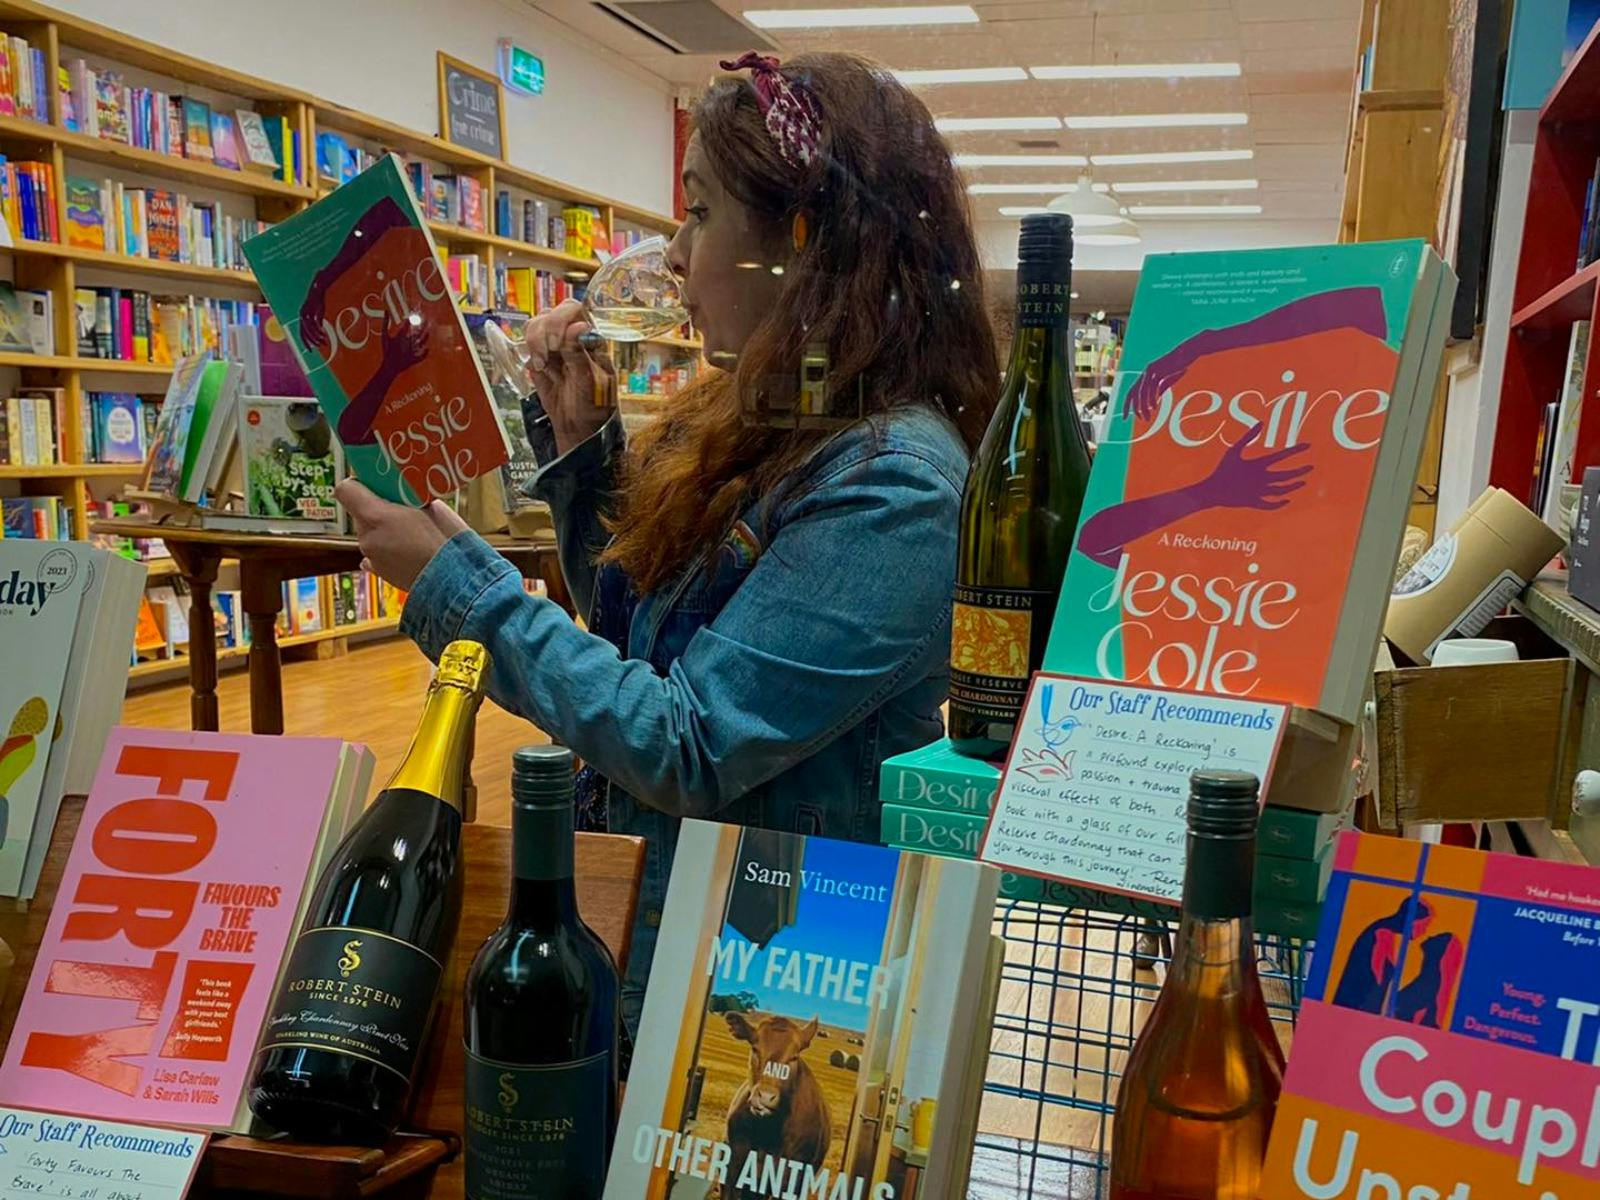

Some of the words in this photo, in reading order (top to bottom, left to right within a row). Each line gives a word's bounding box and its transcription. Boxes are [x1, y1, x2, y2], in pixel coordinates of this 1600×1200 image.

[374, 396, 473, 476] Jessie
[289, 462, 330, 478] Step-
[397, 446, 480, 509] Cole
[281, 476, 305, 492] by-
[302, 484, 335, 500] step
[1159, 533, 1170, 546] A
[1173, 533, 1258, 557] Reckoning
[46, 566, 68, 576] 2023
[0, 570, 57, 617] day
[987, 594, 1032, 607] STEIN
[1088, 552, 1300, 630] Jessie
[1096, 621, 1262, 697] Cole
[1069, 686, 1103, 711] Our
[1105, 690, 1151, 715] Staff
[1151, 695, 1275, 731] Recommends
[1136, 730, 1147, 742] A
[1223, 746, 1237, 757] is
[1099, 751, 1148, 768] profound
[1081, 769, 1121, 784] passion
[1142, 780, 1181, 794] trauma
[1011, 783, 1051, 797] visceral
[1059, 788, 1100, 805] effects
[1110, 796, 1122, 806] of
[1005, 802, 1026, 817] book
[1034, 808, 1059, 820] with
[1066, 815, 1073, 824] a
[1080, 818, 1111, 833] glass
[1118, 823, 1131, 836] of
[1136, 828, 1158, 838] our
[998, 820, 1038, 840] Reserve
[1148, 852, 1172, 863] can
[993, 840, 1012, 855] you
[1063, 855, 1084, 868] this
[743, 860, 792, 887] Sam
[800, 869, 888, 902] Vincent
[201, 882, 283, 909] FAVOURS
[1550, 891, 1567, 900] me
[20, 745, 240, 1097] FORTY
[219, 906, 255, 930] THE
[1514, 907, 1592, 929] JACQUELINE
[200, 928, 258, 954] BRAVE
[1562, 930, 1596, 947] Before
[706, 935, 760, 983] MY
[762, 945, 893, 1010] FATHER
[215, 1001, 232, 1010] away
[288, 979, 348, 993] ROBERT
[352, 984, 402, 1009] STEIN
[309, 991, 340, 1001] SINCE
[1502, 981, 1546, 1008] Young.
[299, 1010, 359, 1033] Chardonnay
[1489, 1002, 1542, 1026] Perfect.
[1464, 1015, 1538, 1044] Dangerous.
[310, 1031, 329, 1040] WINE
[341, 1037, 380, 1054] AUSTRALIA
[152, 1068, 177, 1084] Lisa
[762, 1060, 790, 1081] AND
[143, 1086, 153, 1099] &
[155, 1086, 189, 1102] Sarah
[190, 1088, 220, 1105] Wills
[519, 1115, 574, 1132] STEIN
[0, 1114, 33, 1138] Our
[34, 1118, 82, 1142] Staff
[79, 1124, 195, 1158] Recommends
[67, 1159, 113, 1178] Favours
[121, 1168, 141, 1181] The
[632, 1123, 731, 1185] OTHER
[735, 1148, 895, 1200] ANIMALS
[60, 1184, 72, 1197] is
[80, 1187, 98, 1198] all
[106, 1190, 142, 1200] about
